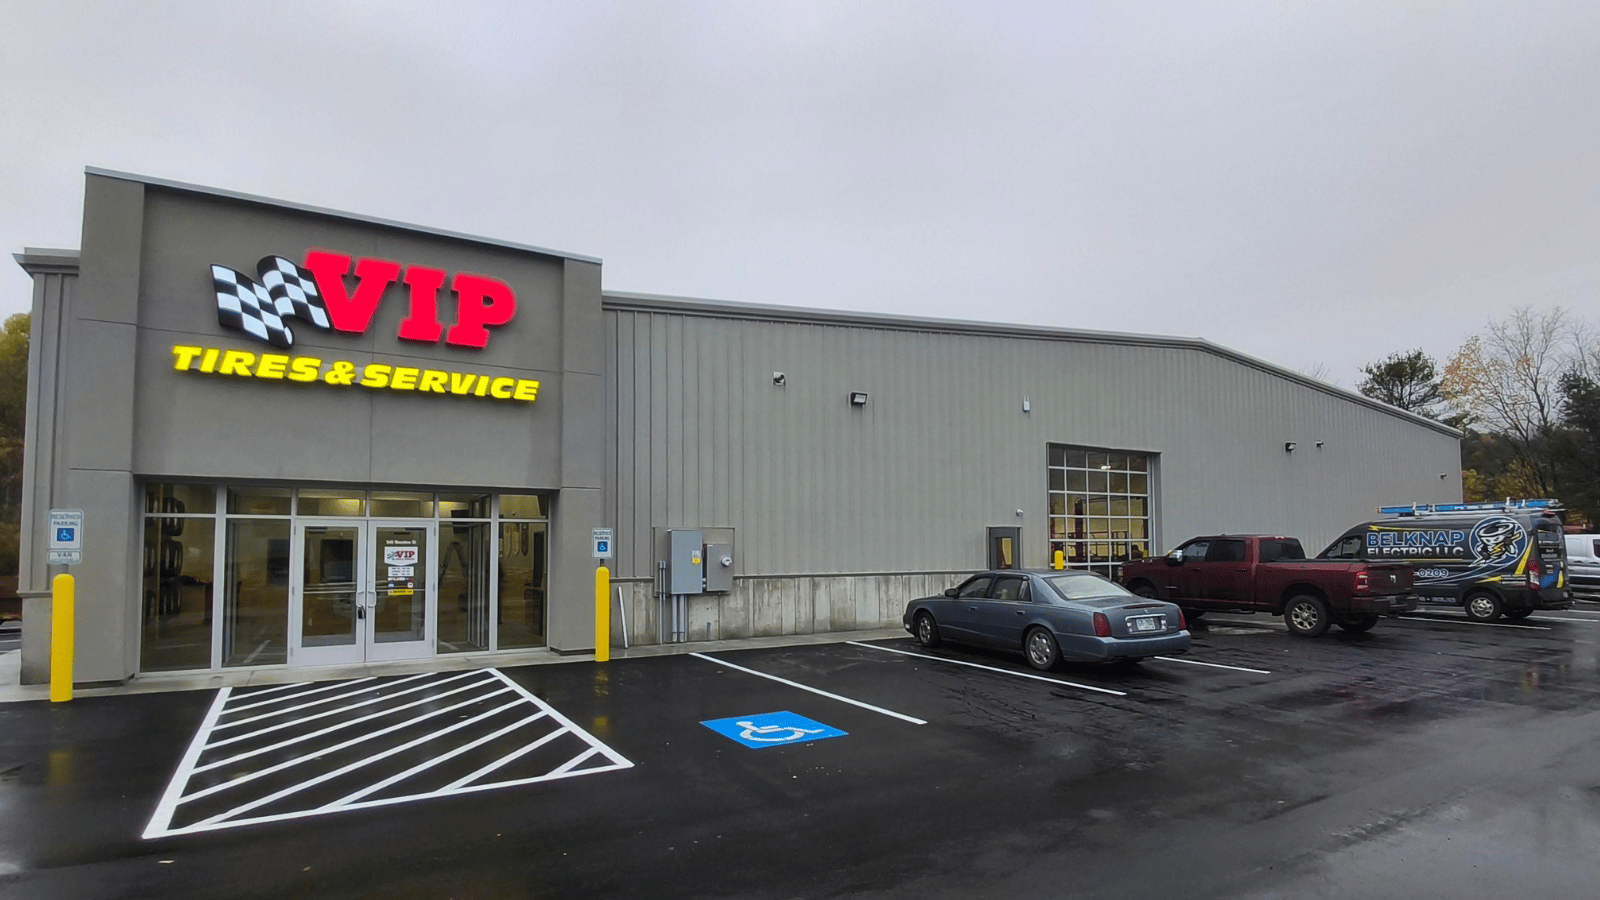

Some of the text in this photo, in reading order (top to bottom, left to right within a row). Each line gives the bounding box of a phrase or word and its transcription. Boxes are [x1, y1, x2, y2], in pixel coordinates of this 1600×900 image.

[304, 250, 518, 349] VIP
[173, 345, 540, 401] TIRES & SERVICE
[1366, 530, 1465, 547] BELKNAP
[1367, 547, 1464, 557] ELECTRIC LLC
